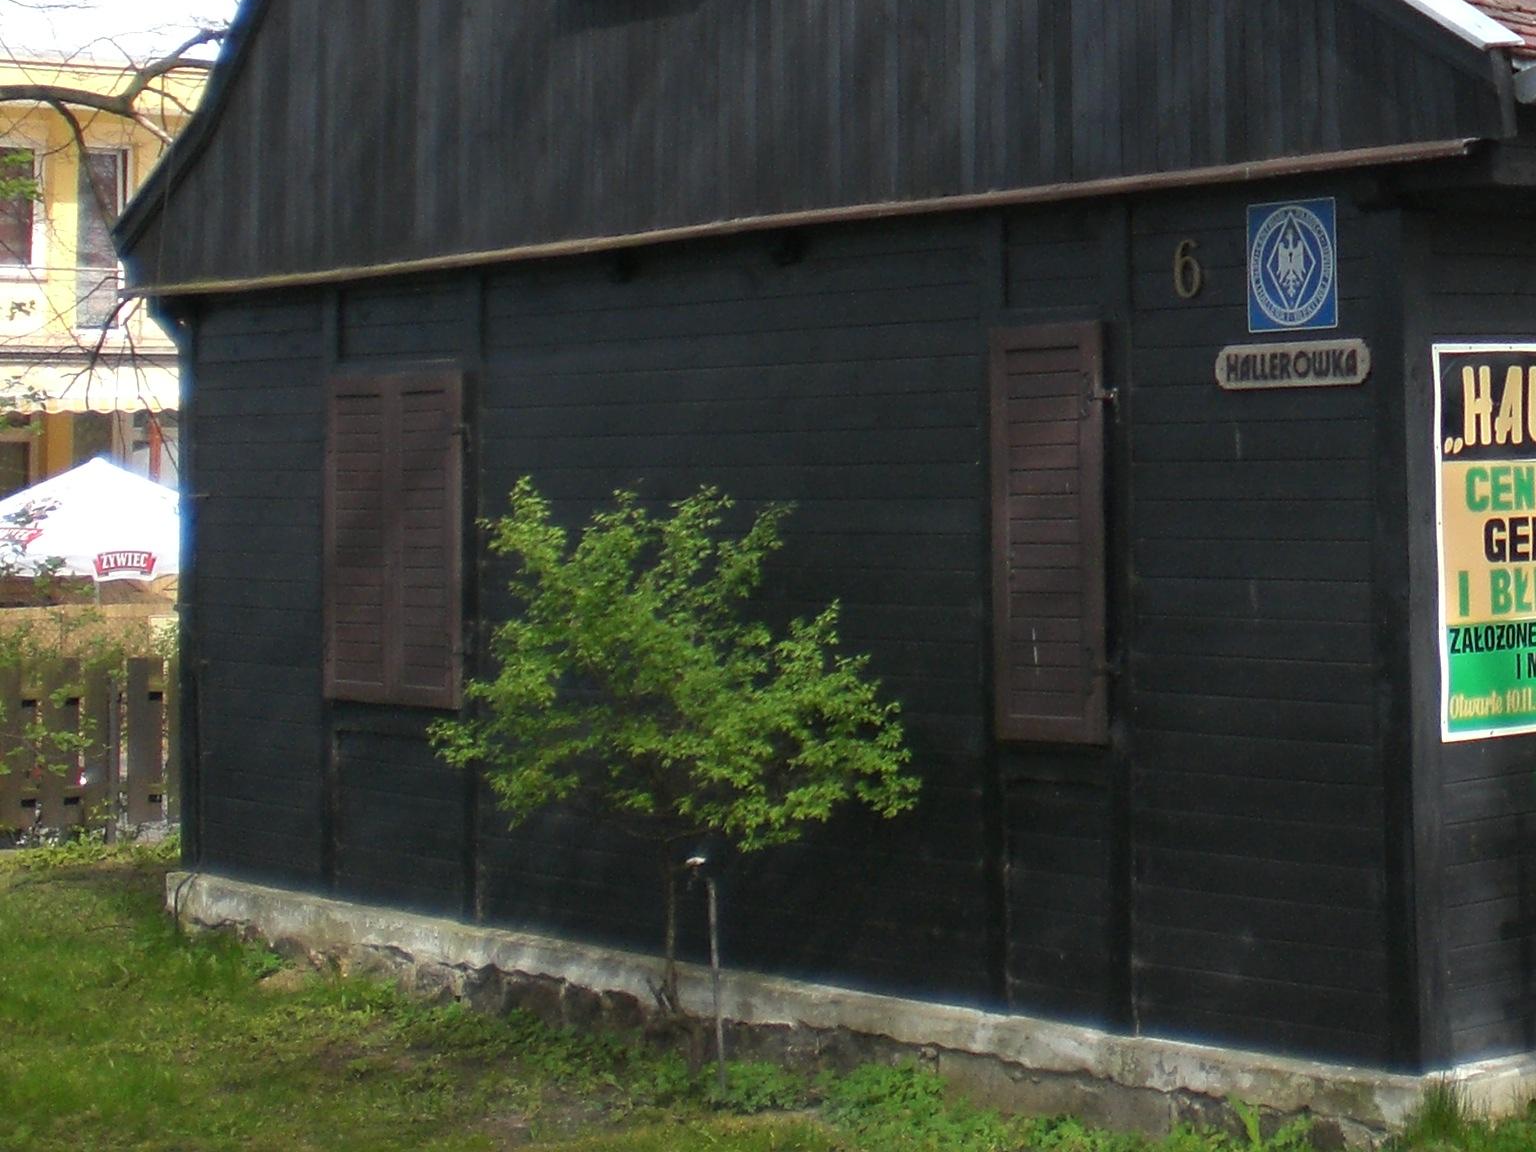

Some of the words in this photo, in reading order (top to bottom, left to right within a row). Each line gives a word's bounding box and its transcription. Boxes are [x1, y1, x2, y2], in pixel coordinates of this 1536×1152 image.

[1174, 238, 1201, 298] 6
[1458, 570, 1470, 617] I
[1515, 652, 1522, 680] I
